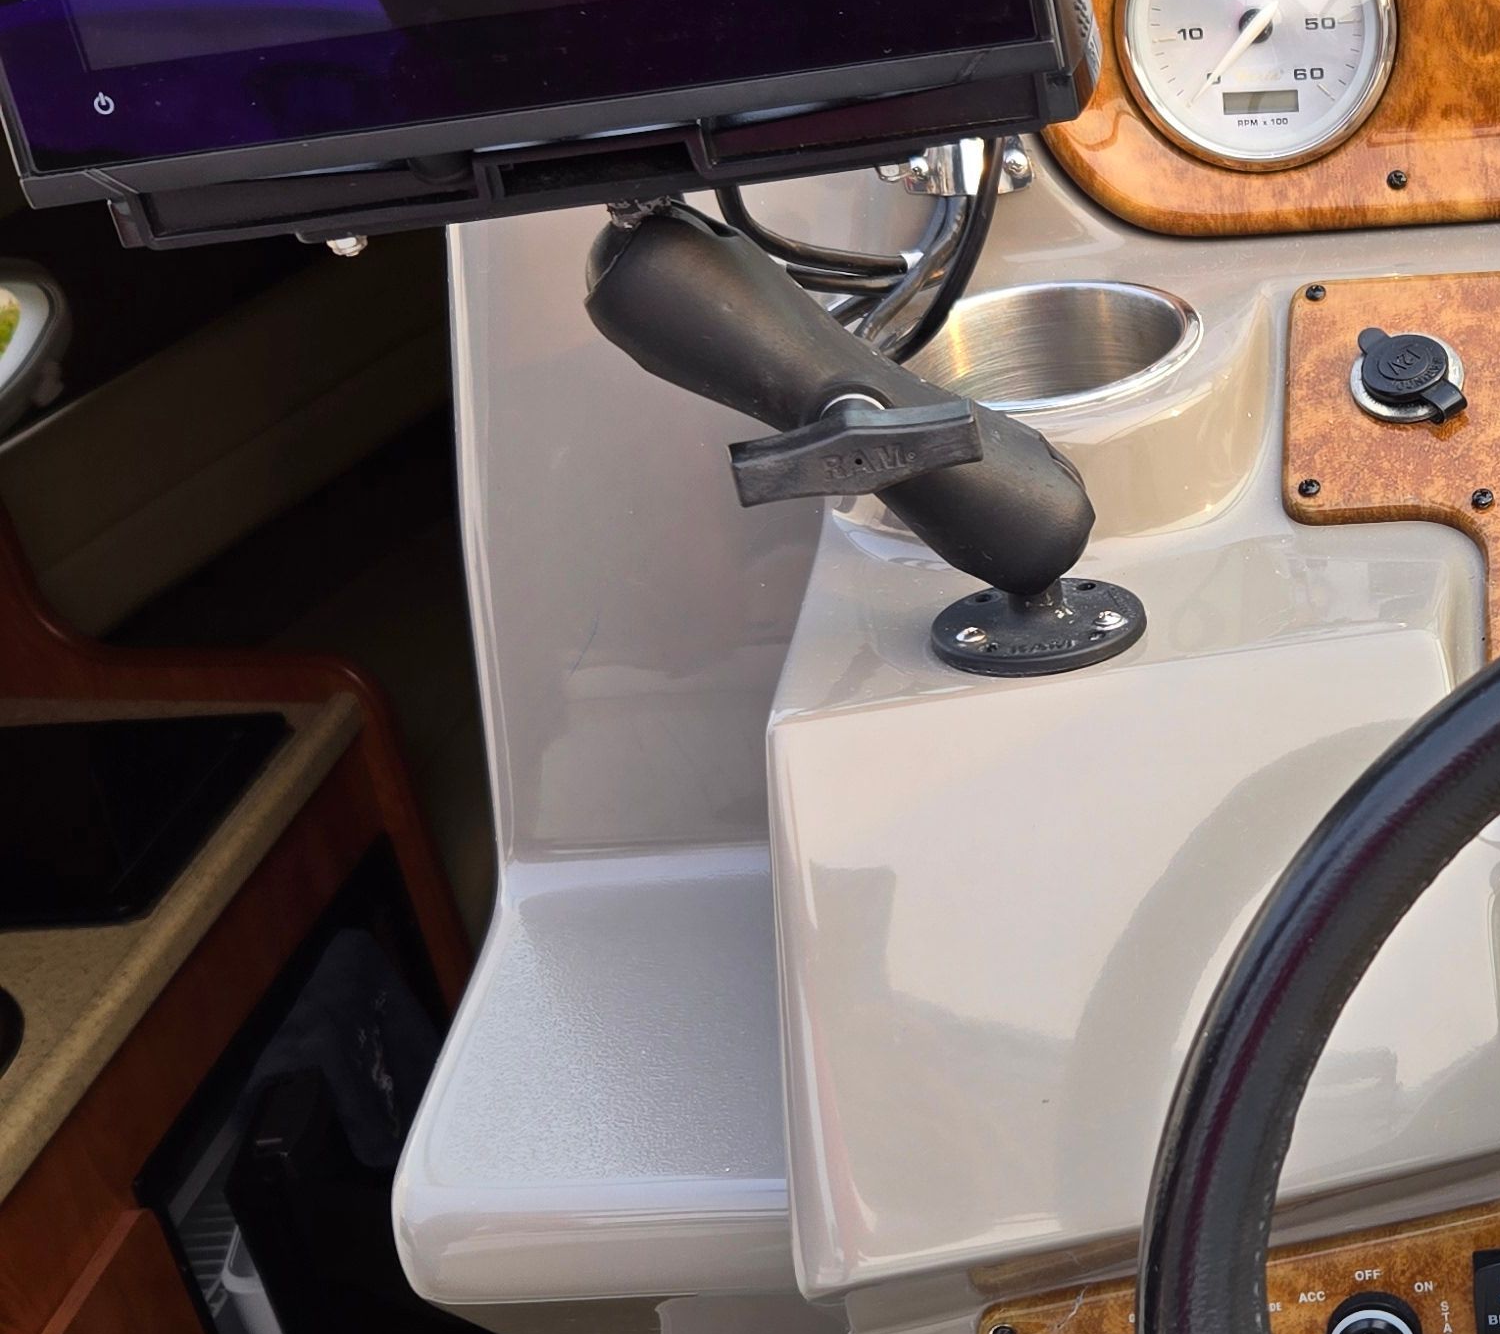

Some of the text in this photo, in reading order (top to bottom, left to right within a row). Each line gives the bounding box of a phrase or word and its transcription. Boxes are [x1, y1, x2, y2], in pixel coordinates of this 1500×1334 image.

[1305, 17, 1336, 30] 50
[1177, 27, 1204, 40] 10
[1294, 67, 1324, 80] 60
[1237, 119, 1258, 127] RPM
[1271, 117, 1288, 126] 100
[824, 444, 906, 479] RAM
[1355, 1269, 1382, 1281] OFF
[1414, 1281, 1434, 1293] ON
[1298, 1291, 1326, 1303] ACC
